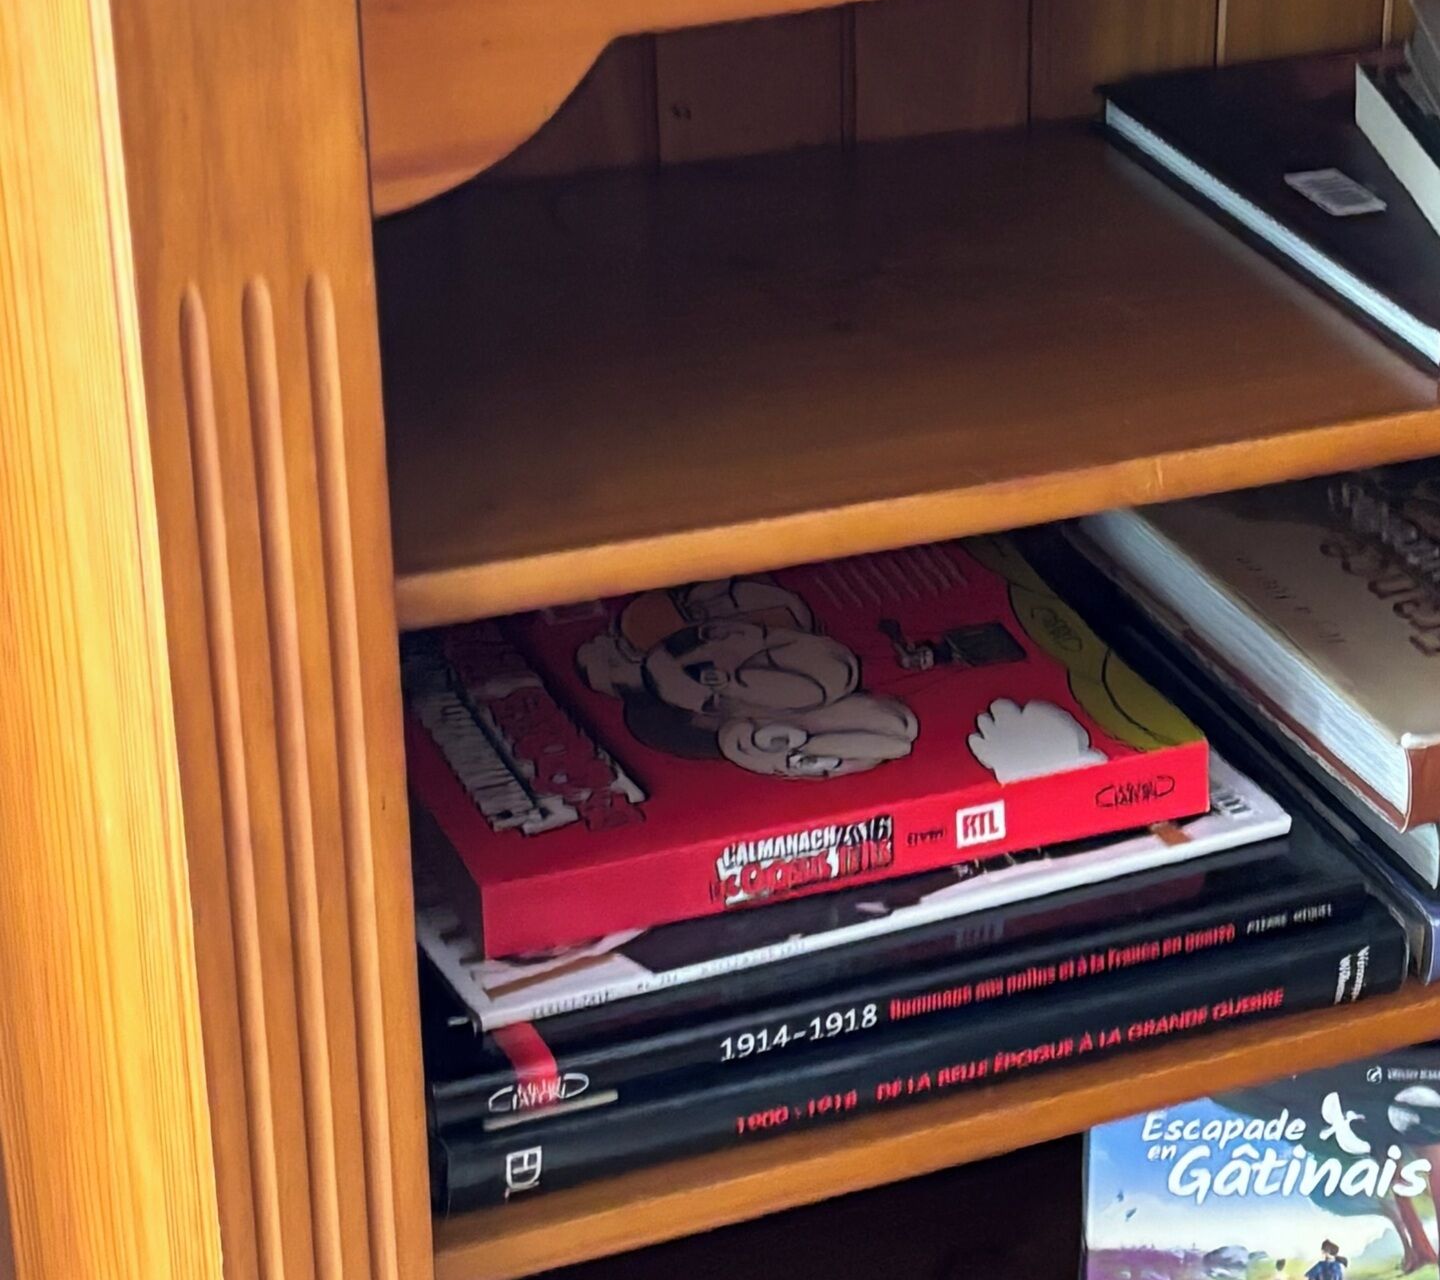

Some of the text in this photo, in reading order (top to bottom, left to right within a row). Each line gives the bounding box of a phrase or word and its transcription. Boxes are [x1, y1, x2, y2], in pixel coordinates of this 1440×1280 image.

[721, 823, 837, 869] L'ALMANACH
[961, 811, 1000, 839] RTL
[718, 1002, 880, 1062] 1914-1918
[735, 1104, 789, 1136] 1900
[906, 1071, 933, 1094] LA
[1076, 1026, 1094, 1054] À
[1098, 1024, 1123, 1049] LA
[1127, 1006, 1208, 1043] GRANDE
[1212, 987, 1286, 1022] GUERRE
[1141, 1108, 1306, 1145] Escapade
[1147, 1141, 1177, 1162] en
[1166, 1141, 1433, 1204] Gâtinais
